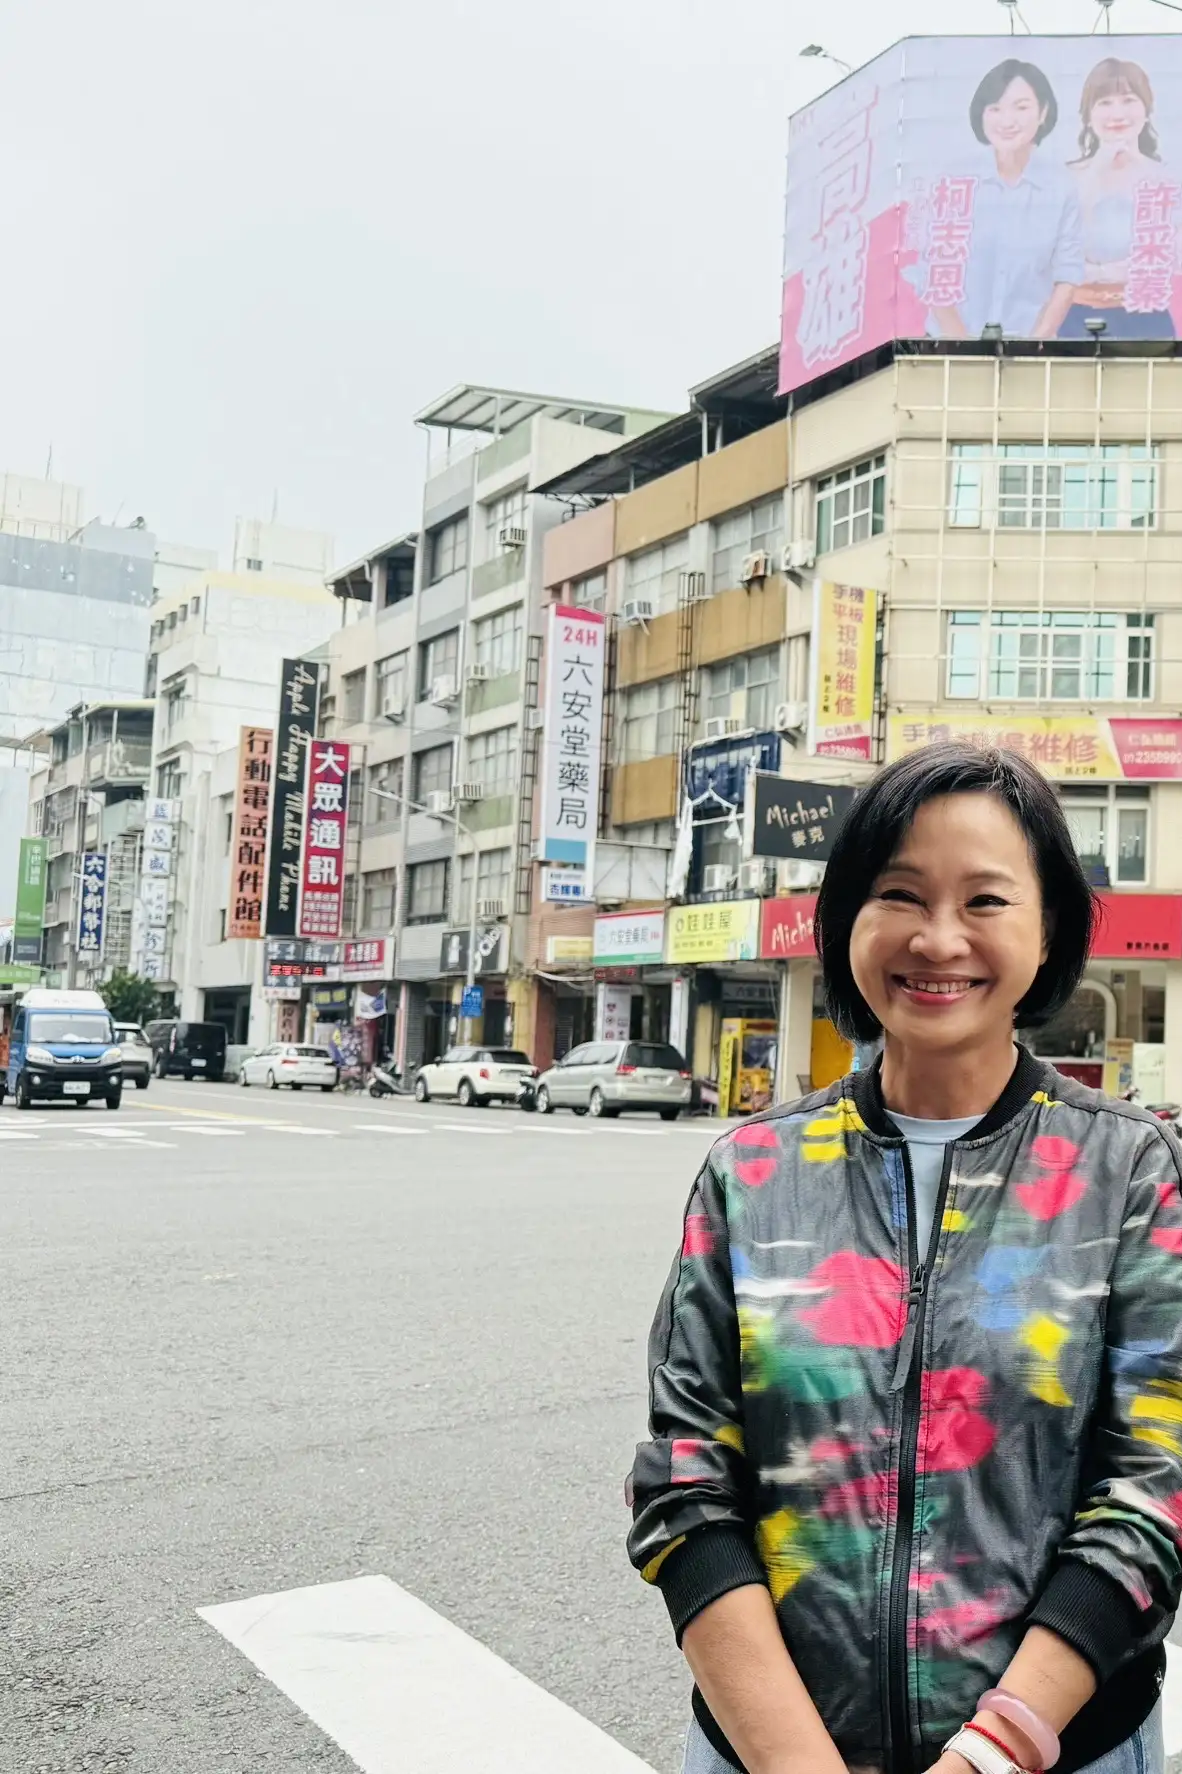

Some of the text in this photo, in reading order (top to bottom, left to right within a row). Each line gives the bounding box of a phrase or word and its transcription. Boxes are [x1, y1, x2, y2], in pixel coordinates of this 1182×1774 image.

[923, 177, 978, 306] 柯志恩
[563, 626, 598, 647] 24H
[555, 653, 595, 830] 六安堂藥局
[307, 746, 346, 886] 大眾通訊
[766, 795, 834, 829] Michael
